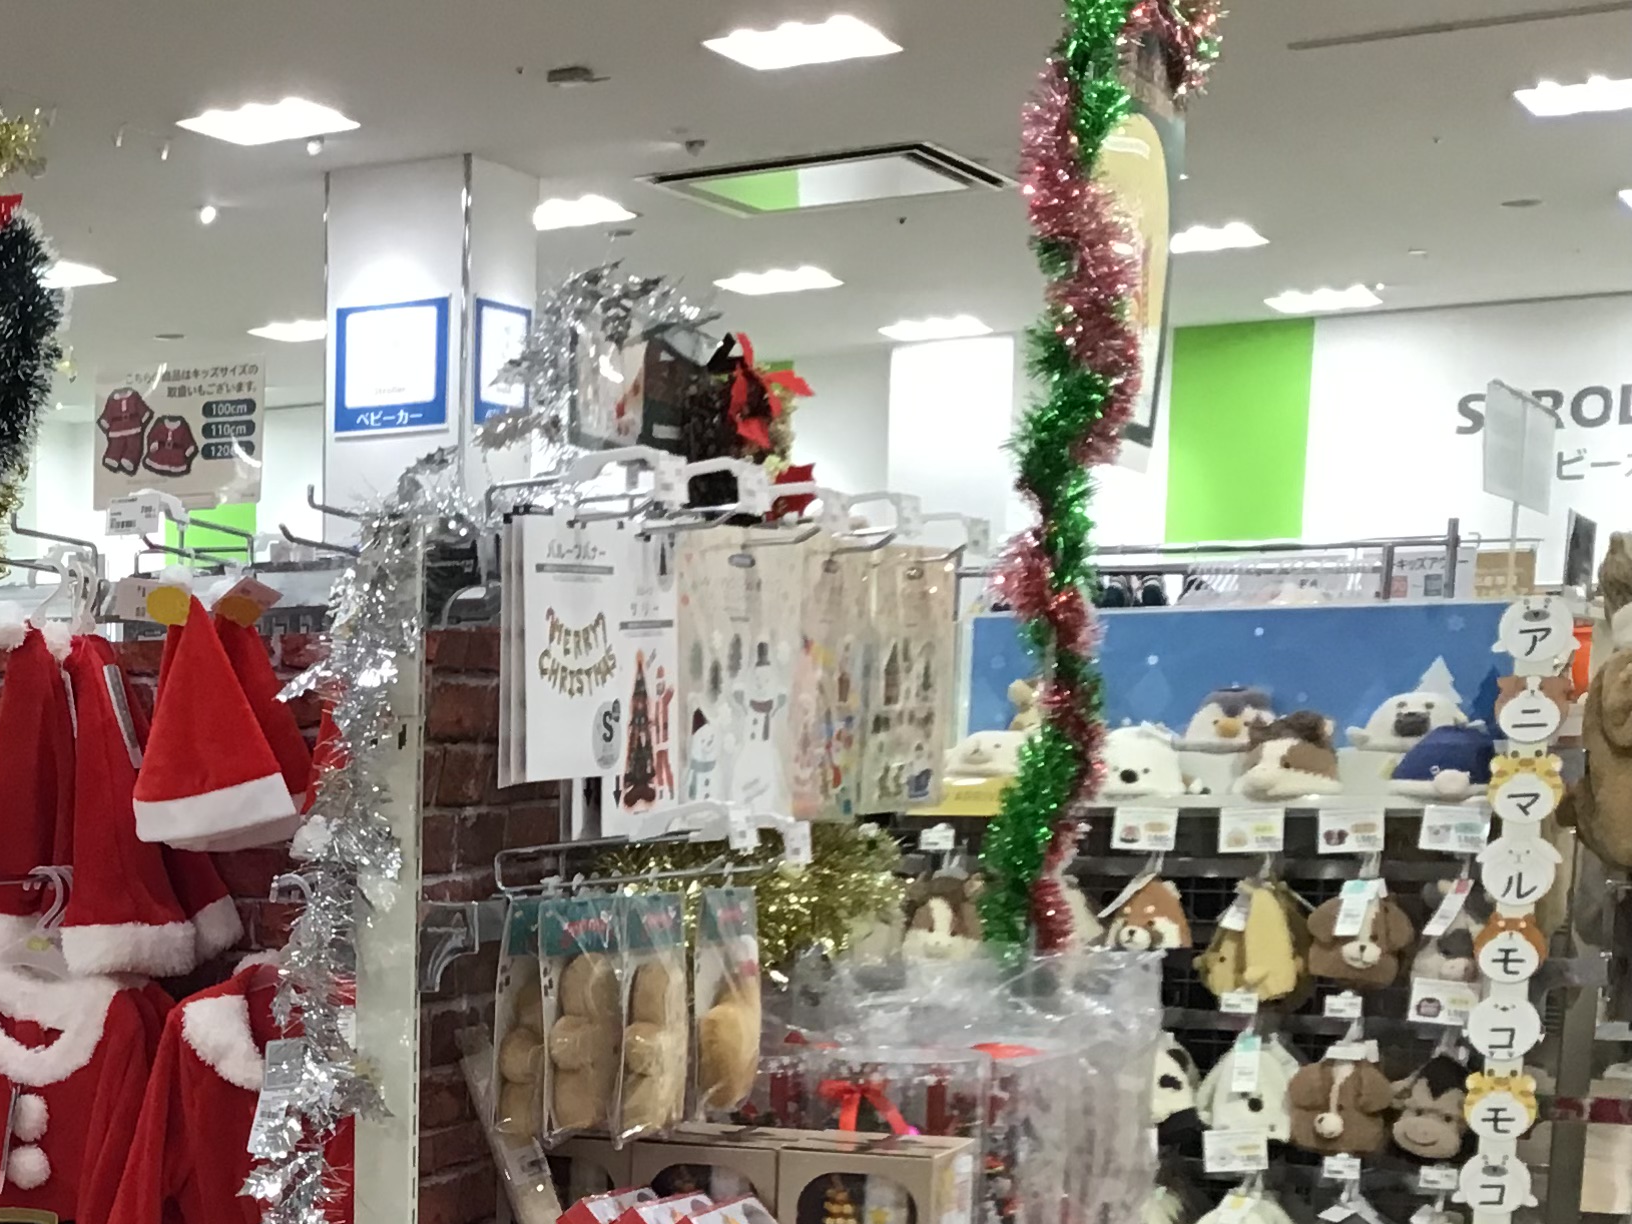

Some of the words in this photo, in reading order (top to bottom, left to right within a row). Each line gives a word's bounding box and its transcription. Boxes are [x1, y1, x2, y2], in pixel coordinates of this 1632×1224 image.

[211, 403, 248, 414] 100cm
[355, 408, 423, 427] ベビーカー
[211, 424, 247, 436] 110cm
